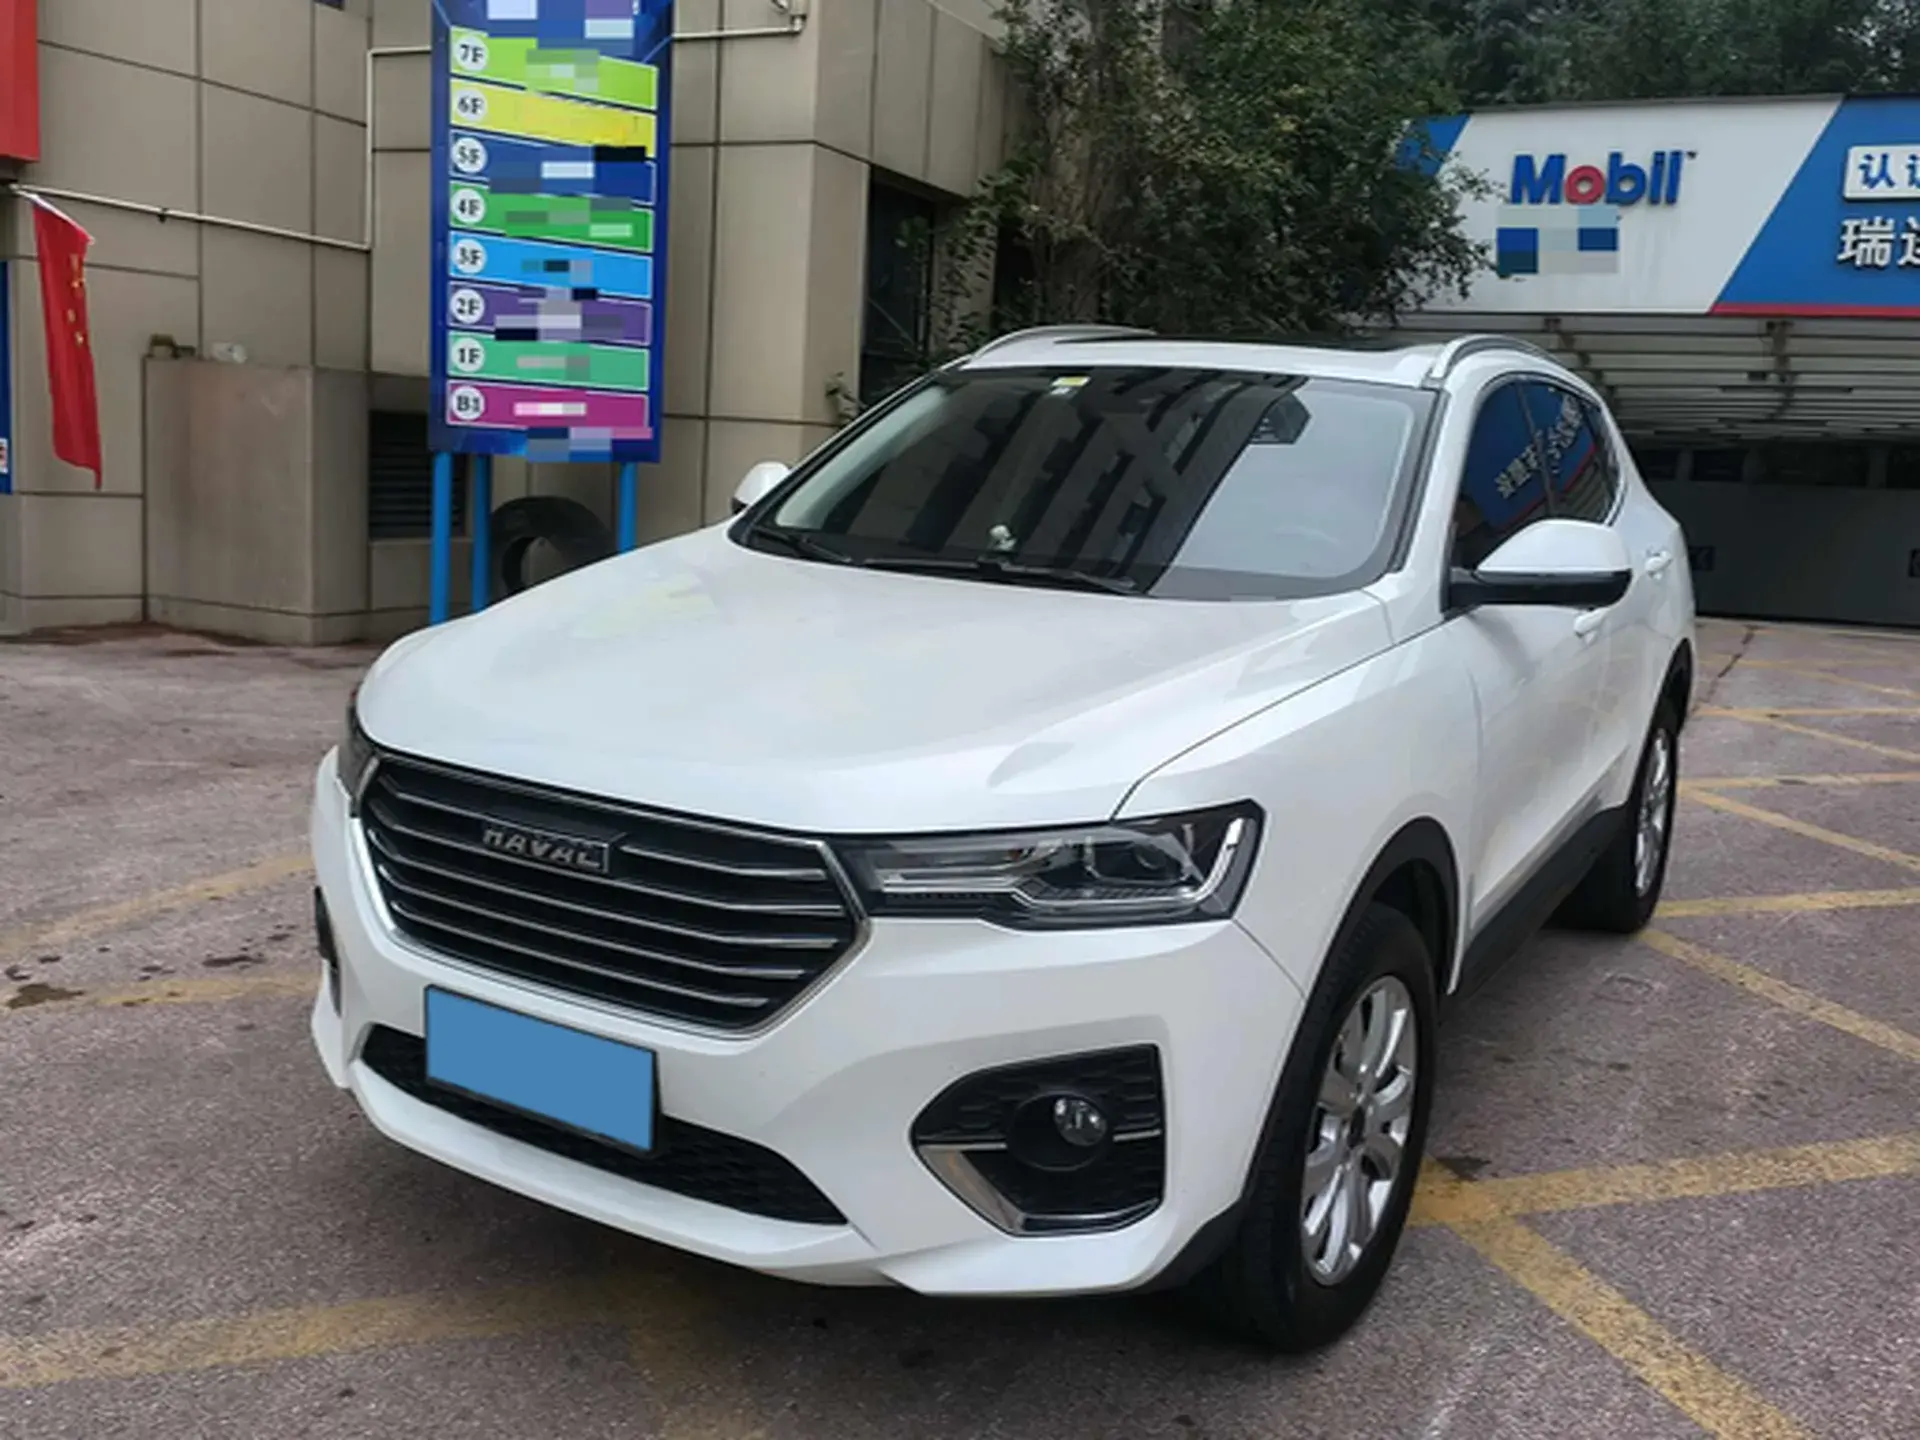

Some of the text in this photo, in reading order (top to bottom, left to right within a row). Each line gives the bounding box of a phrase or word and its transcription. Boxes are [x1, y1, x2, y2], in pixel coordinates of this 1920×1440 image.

[459, 43, 484, 63] 7F
[458, 96, 483, 115] 6F
[458, 148, 478, 168] 5F
[1510, 150, 1682, 206] Mobil
[457, 198, 480, 217] 4F
[458, 245, 480, 267] 3F
[456, 297, 480, 317] 2F
[457, 347, 479, 367] 1F
[456, 395, 481, 415] B1
[482, 828, 601, 869] HAVAL
